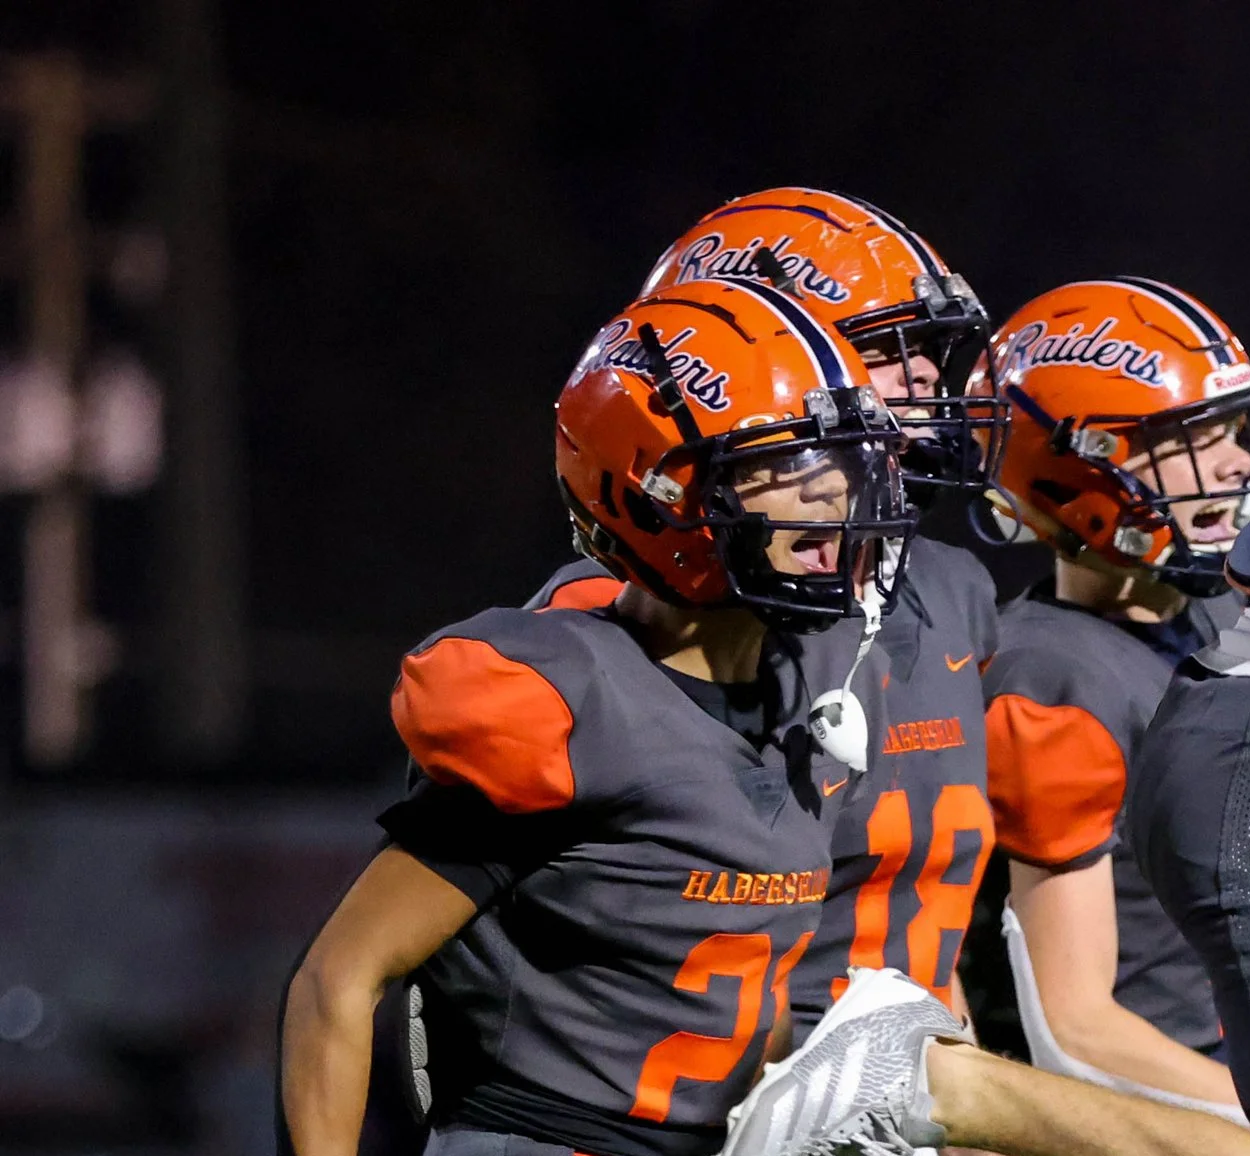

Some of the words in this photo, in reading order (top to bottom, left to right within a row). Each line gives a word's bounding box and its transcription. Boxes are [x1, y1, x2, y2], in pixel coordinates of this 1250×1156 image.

[998, 316, 1167, 389] Raiders
[829, 784, 997, 1011] 18
[627, 930, 816, 1123] 2
